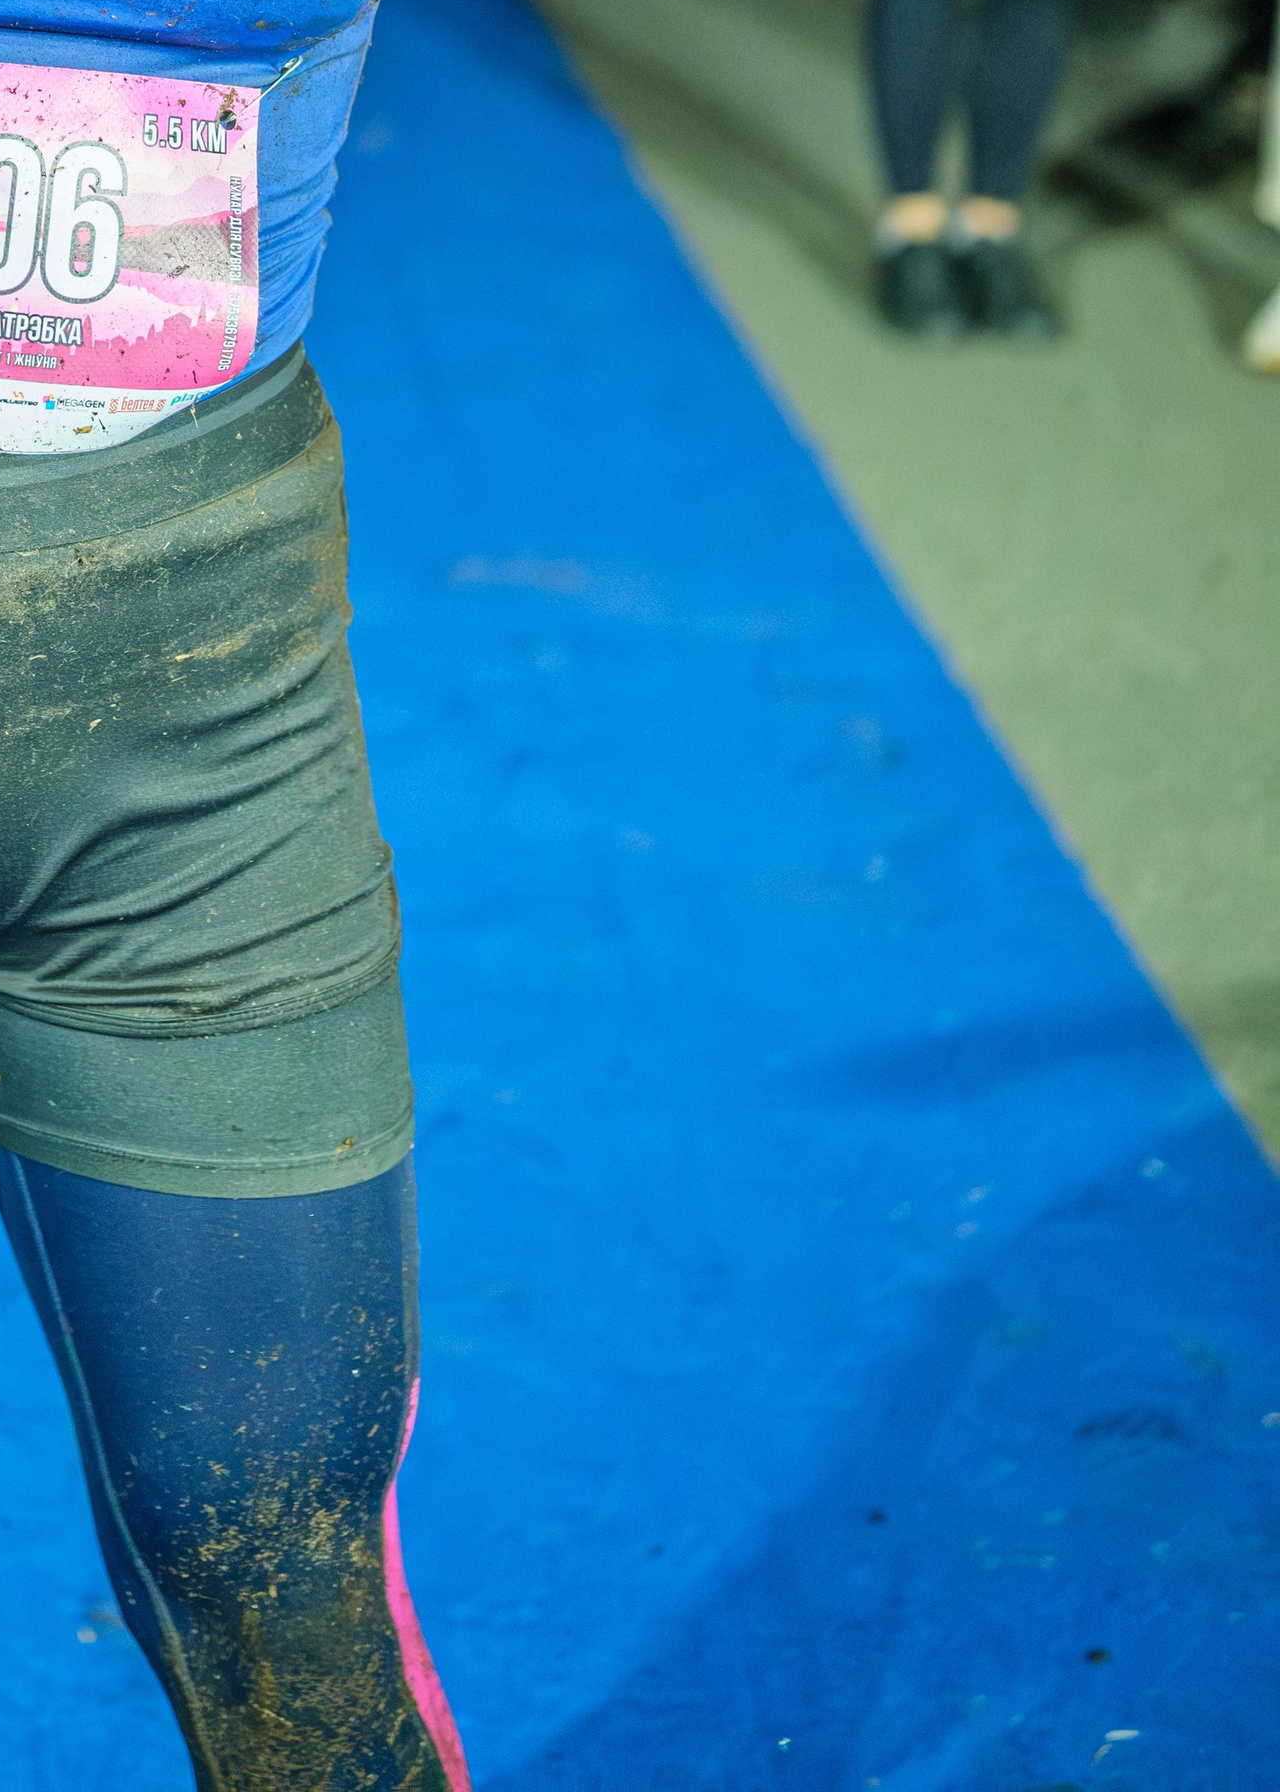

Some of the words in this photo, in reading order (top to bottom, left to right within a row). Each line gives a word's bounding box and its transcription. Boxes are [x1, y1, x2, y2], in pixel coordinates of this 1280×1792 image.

[143, 113, 183, 150] 5.5
[230, 176, 242, 217] НУМАР
[229, 217, 243, 242] ДЛЯ
[217, 293, 241, 371] 375336791705
[6, 353, 11, 365] 1
[13, 353, 58, 370] ЖНІЎНЯ
